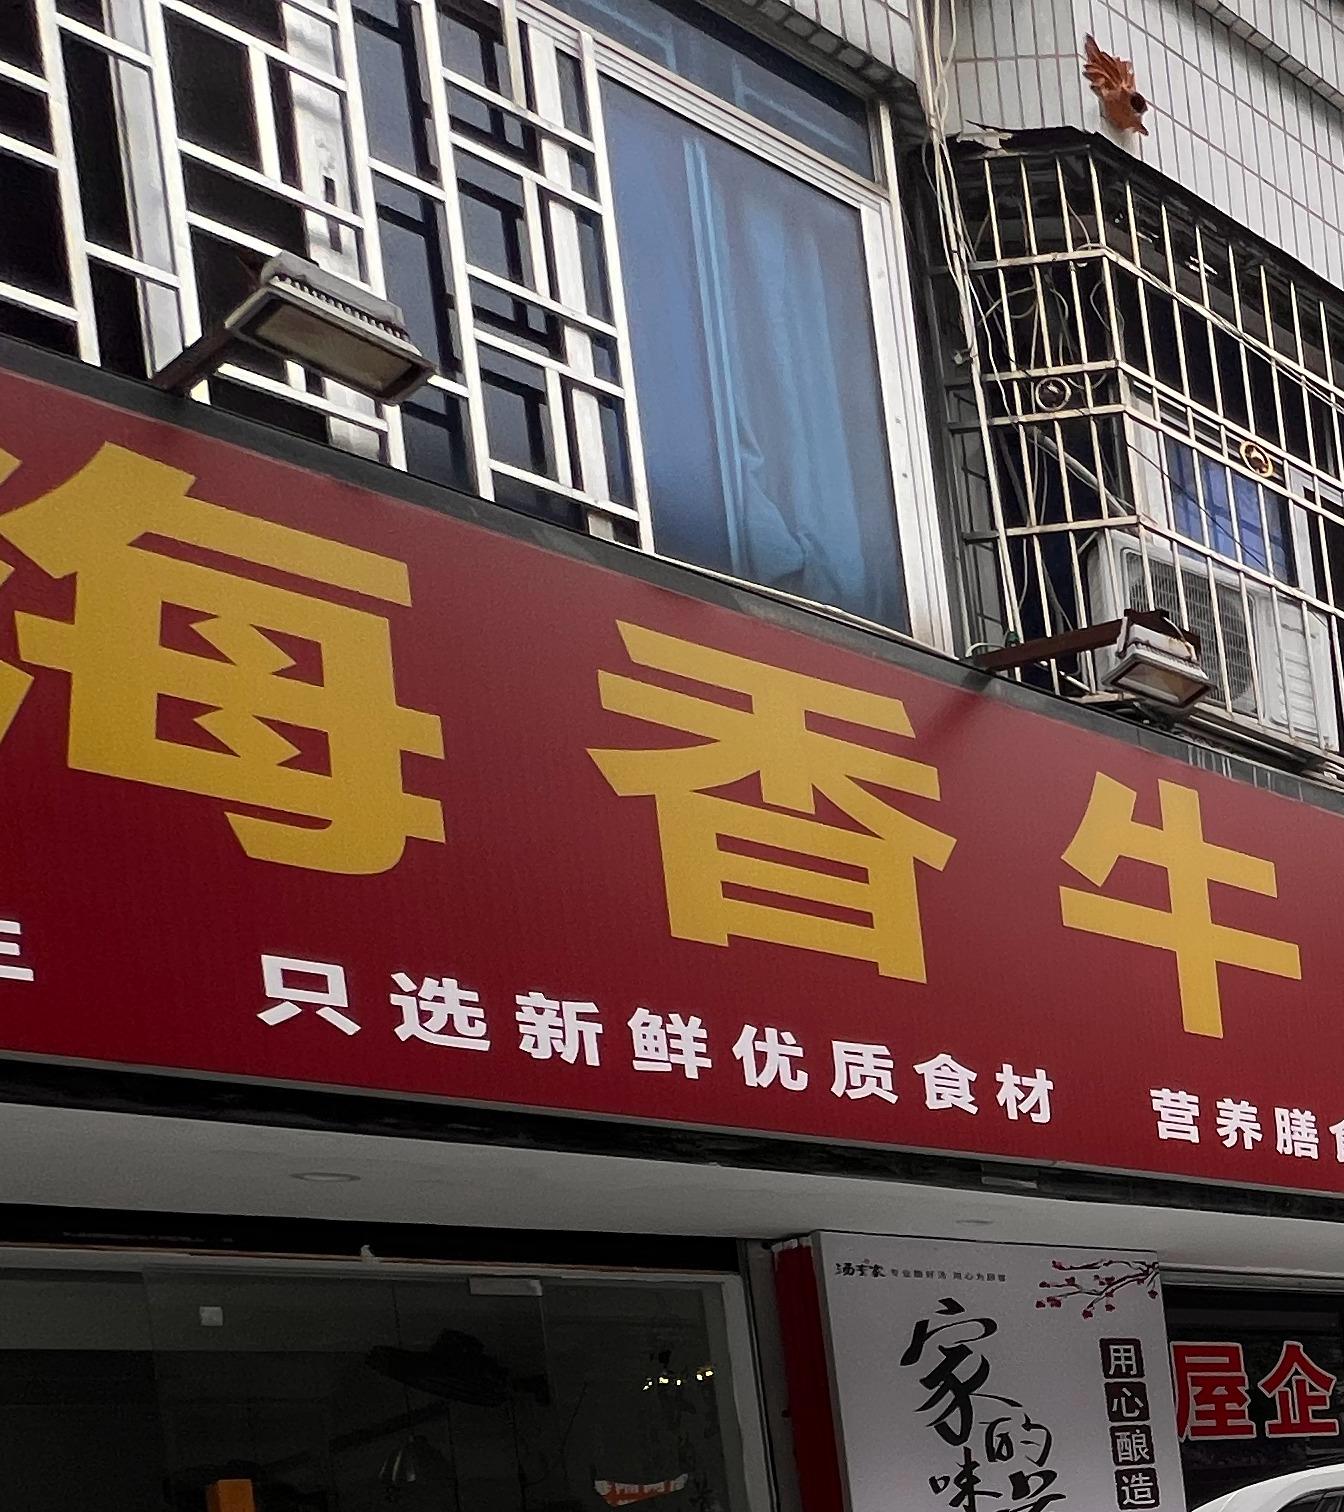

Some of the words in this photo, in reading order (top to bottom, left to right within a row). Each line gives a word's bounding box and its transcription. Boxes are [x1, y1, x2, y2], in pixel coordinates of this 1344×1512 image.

[256, 952, 1054, 1124] 只选新鲜优质食材
[1103, 1341, 1158, 1509] 用心酿造
[1170, 1340, 1340, 1441] 屋企
